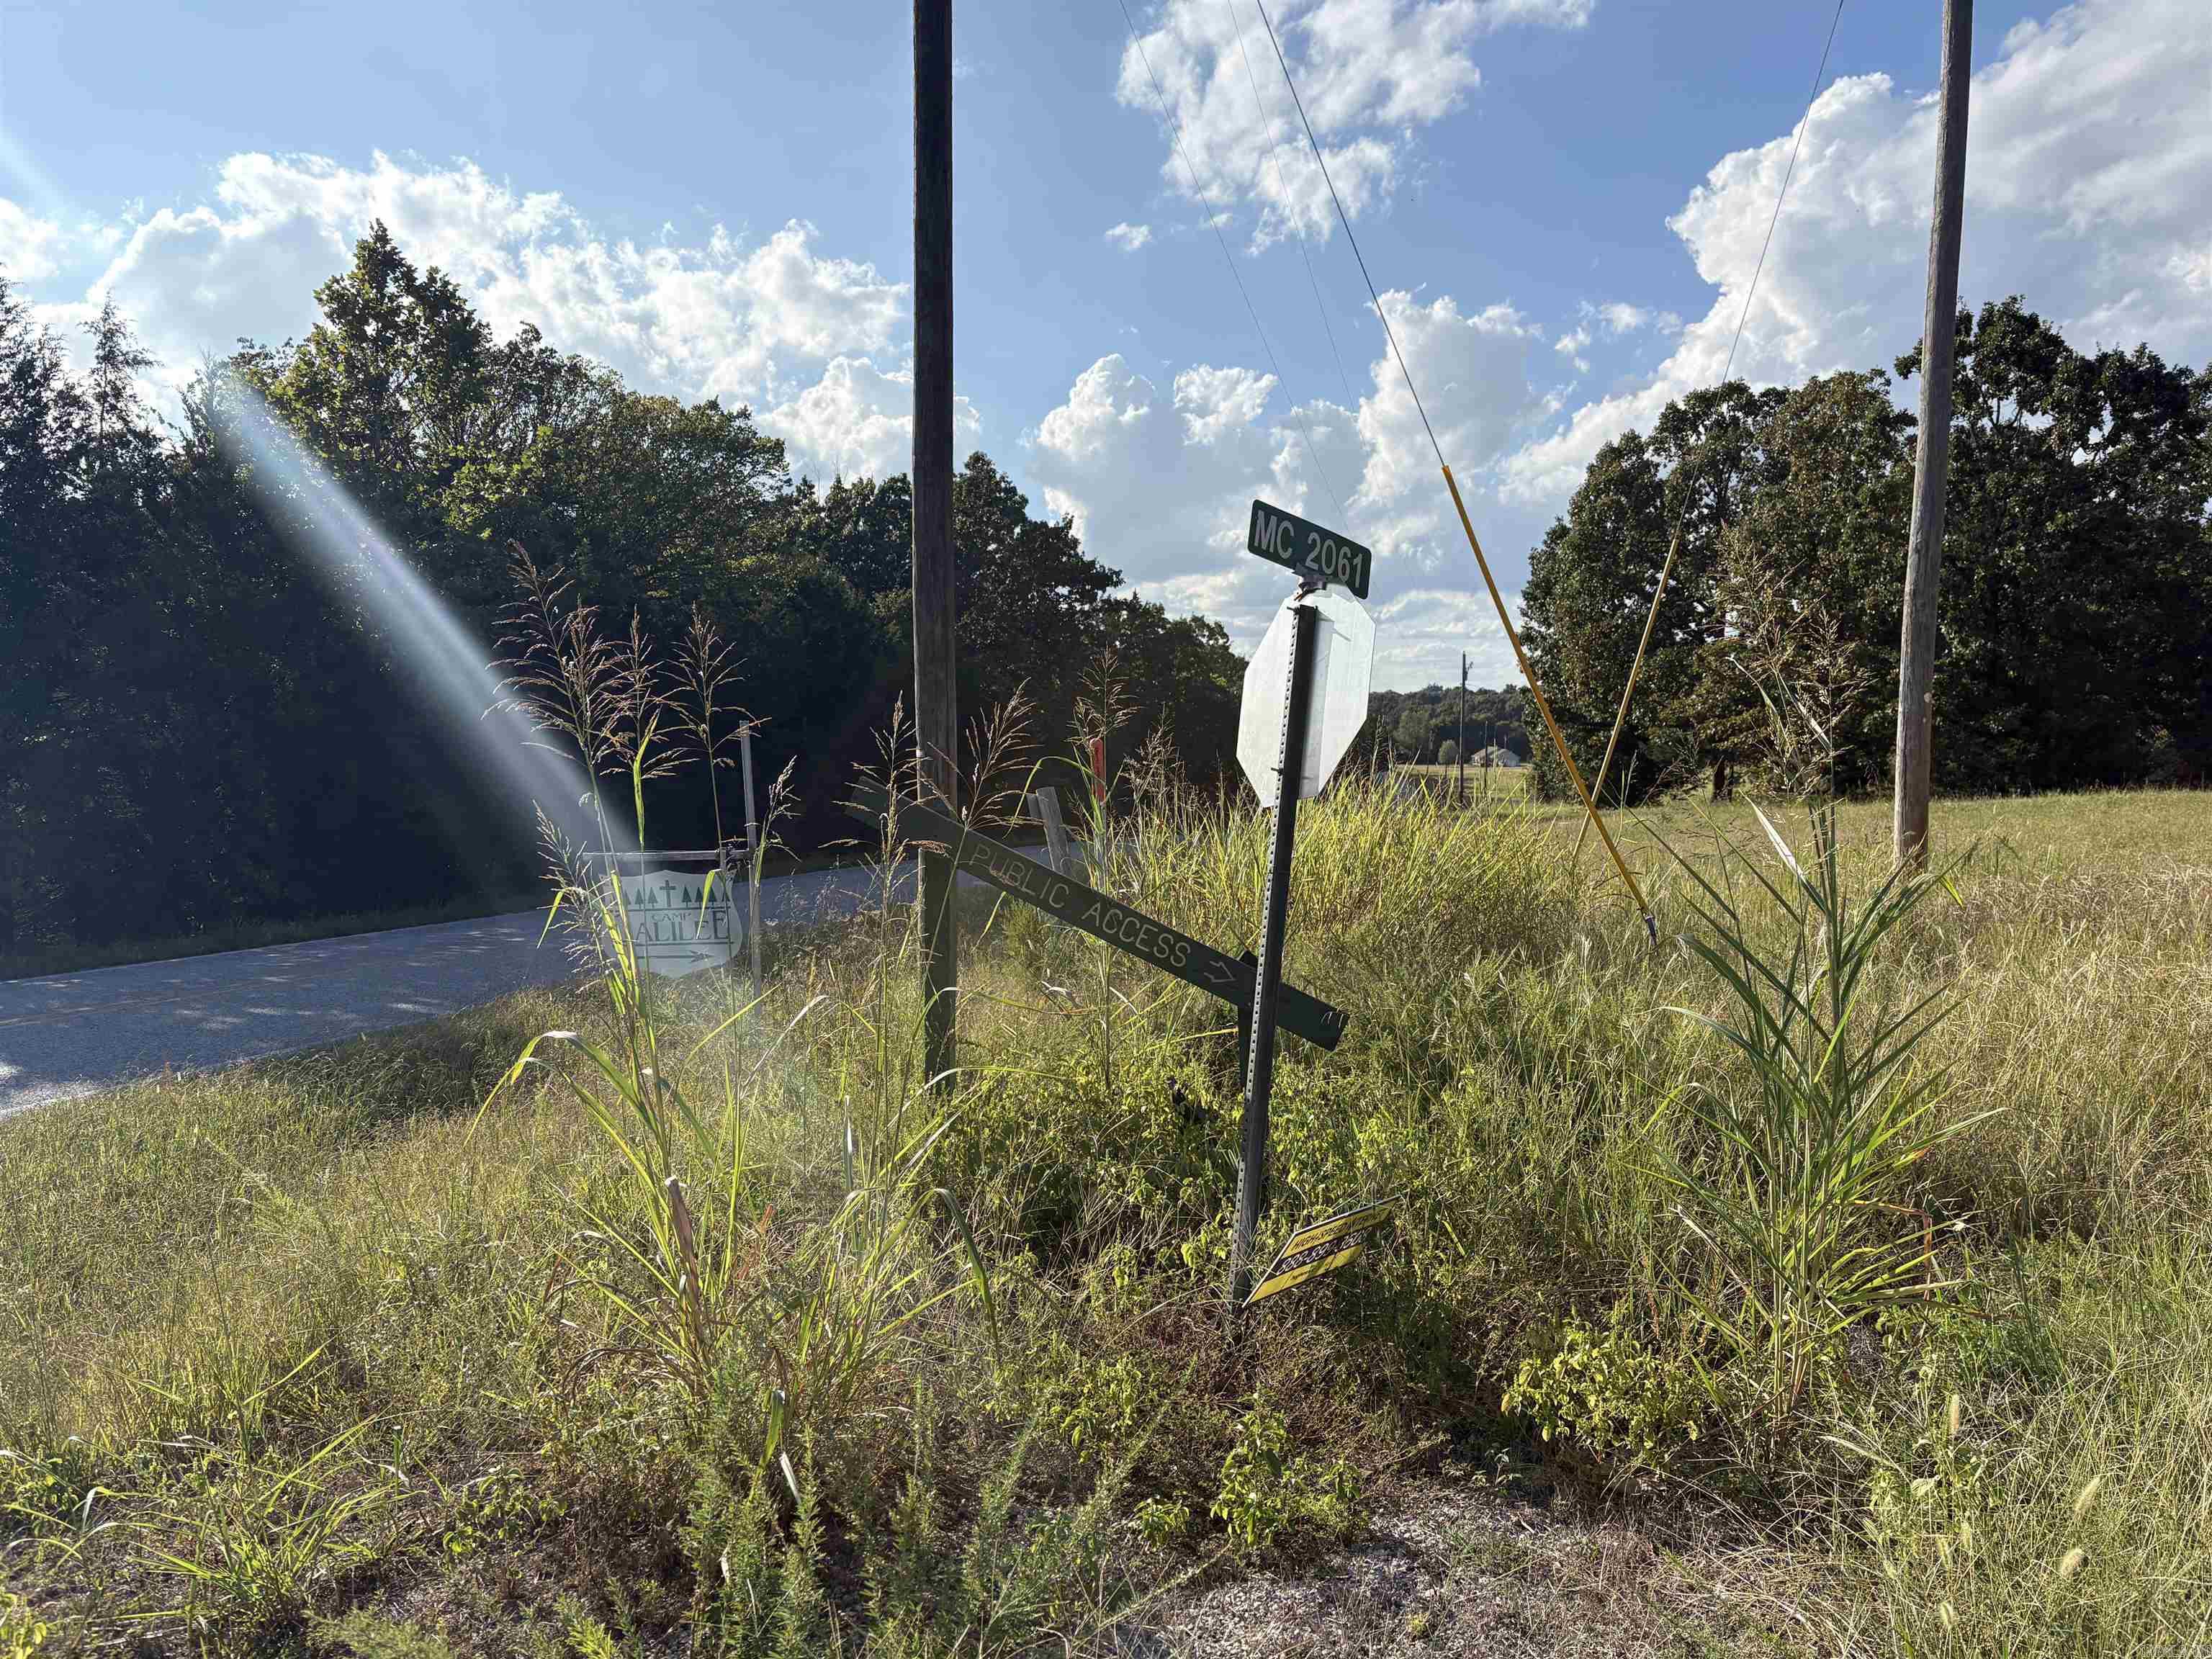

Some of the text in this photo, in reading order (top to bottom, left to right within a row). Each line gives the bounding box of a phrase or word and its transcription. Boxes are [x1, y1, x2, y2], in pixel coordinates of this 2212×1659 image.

[1254, 510, 1363, 588] MC 2061
[612, 909, 729, 941] ALILEE
[652, 912, 692, 922] CAMP
[969, 844, 1191, 967] PUBLIC ACCESS
